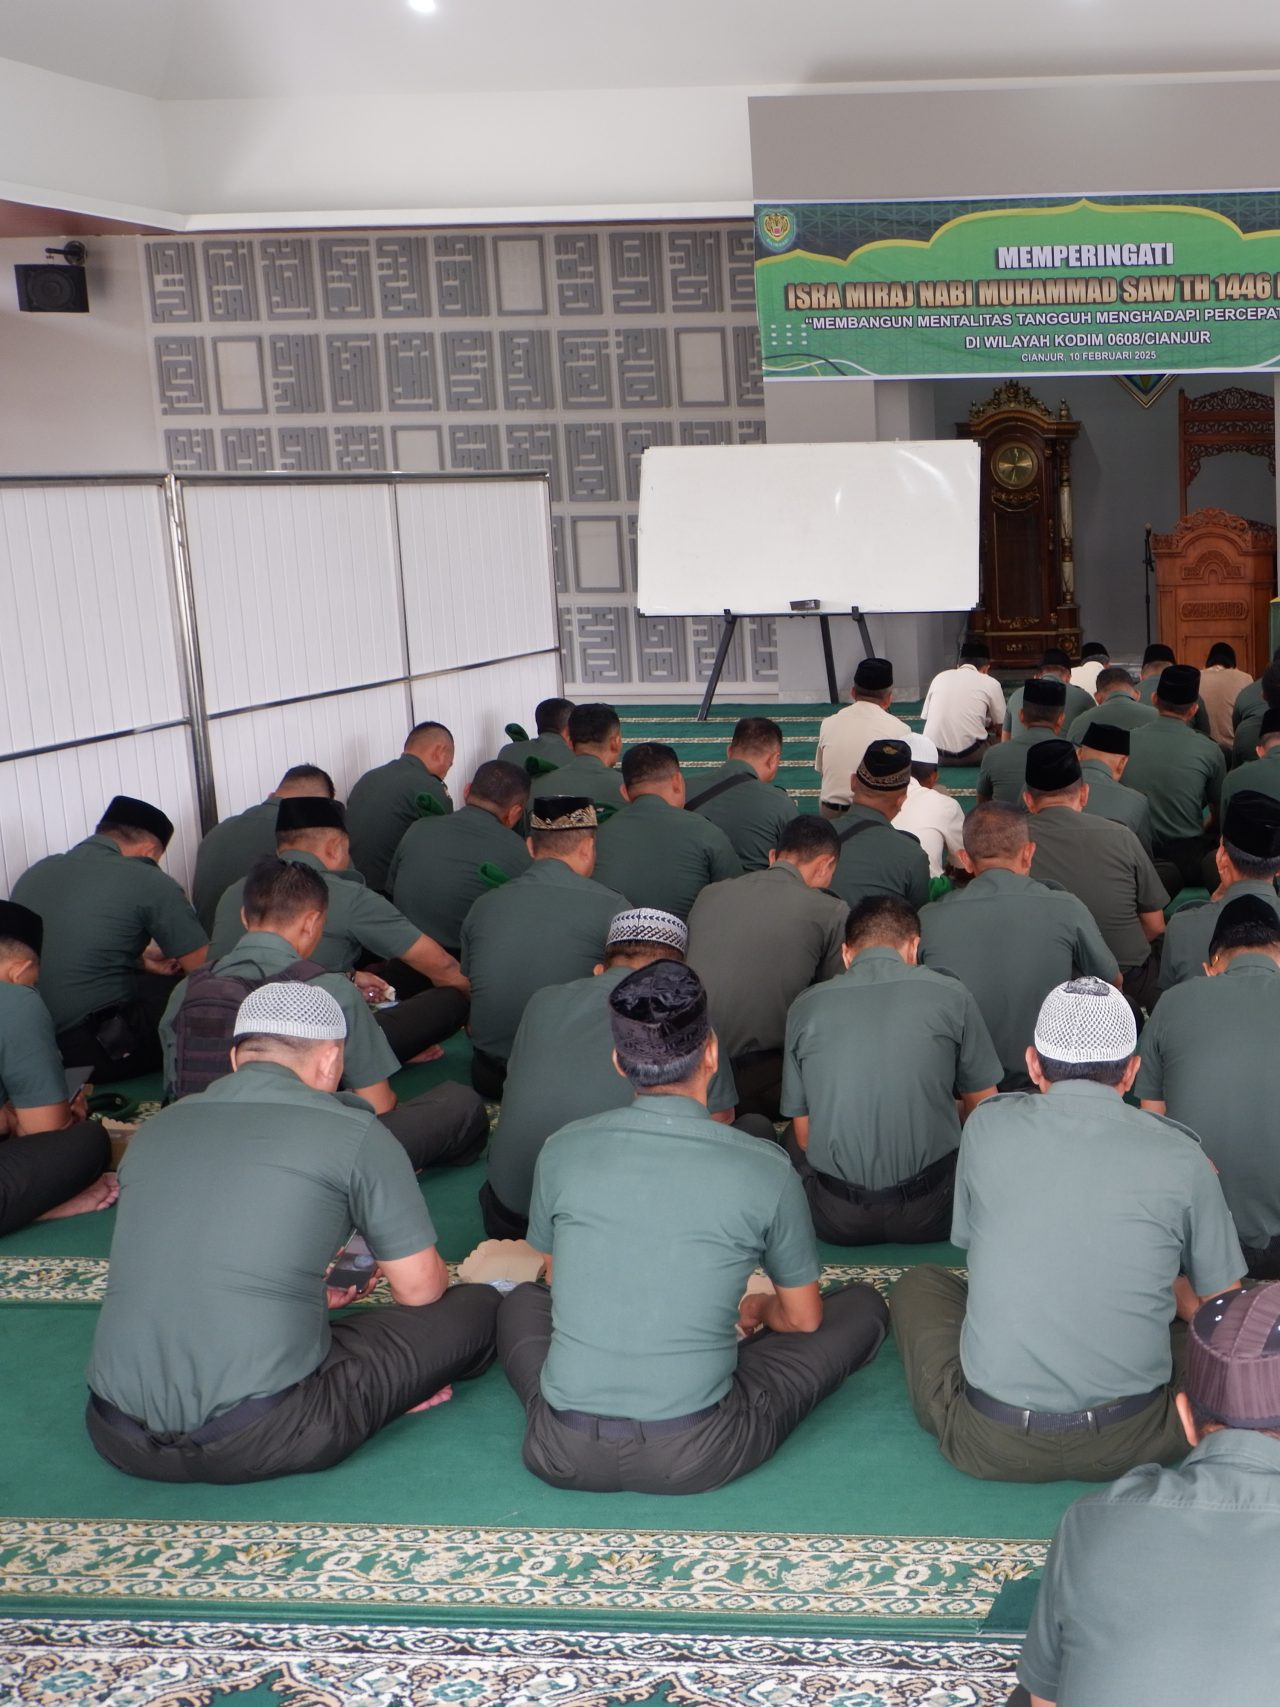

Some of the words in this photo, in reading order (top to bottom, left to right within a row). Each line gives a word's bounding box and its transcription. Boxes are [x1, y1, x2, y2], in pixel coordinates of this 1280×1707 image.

[998, 243, 1174, 268] MEMPERINGATI
[786, 283, 842, 309] ISRA
[844, 281, 914, 308] MIRAJ
[918, 280, 973, 307] NABI
[977, 277, 1118, 306] MUHAMMAD
[1122, 275, 1177, 303] SAW
[1180, 274, 1210, 302] TH
[1214, 273, 1270, 300] 1446
[917, 313, 1012, 328] MENTALITAS
[1016, 311, 1092, 326] TANGGUH
[1096, 309, 1200, 324] MENGHADAPI
[965, 336, 980, 348] DI
[984, 335, 1050, 348] WILAYAH
[1054, 333, 1105, 346] KODIM
[1107, 332, 1212, 345] 0608/CIANJUR
[1021, 352, 1067, 363] CIANJUR,
[1069, 352, 1080, 362] 10
[1083, 351, 1133, 361] FEBRUARI
[1134, 350, 1157, 360] 2025
